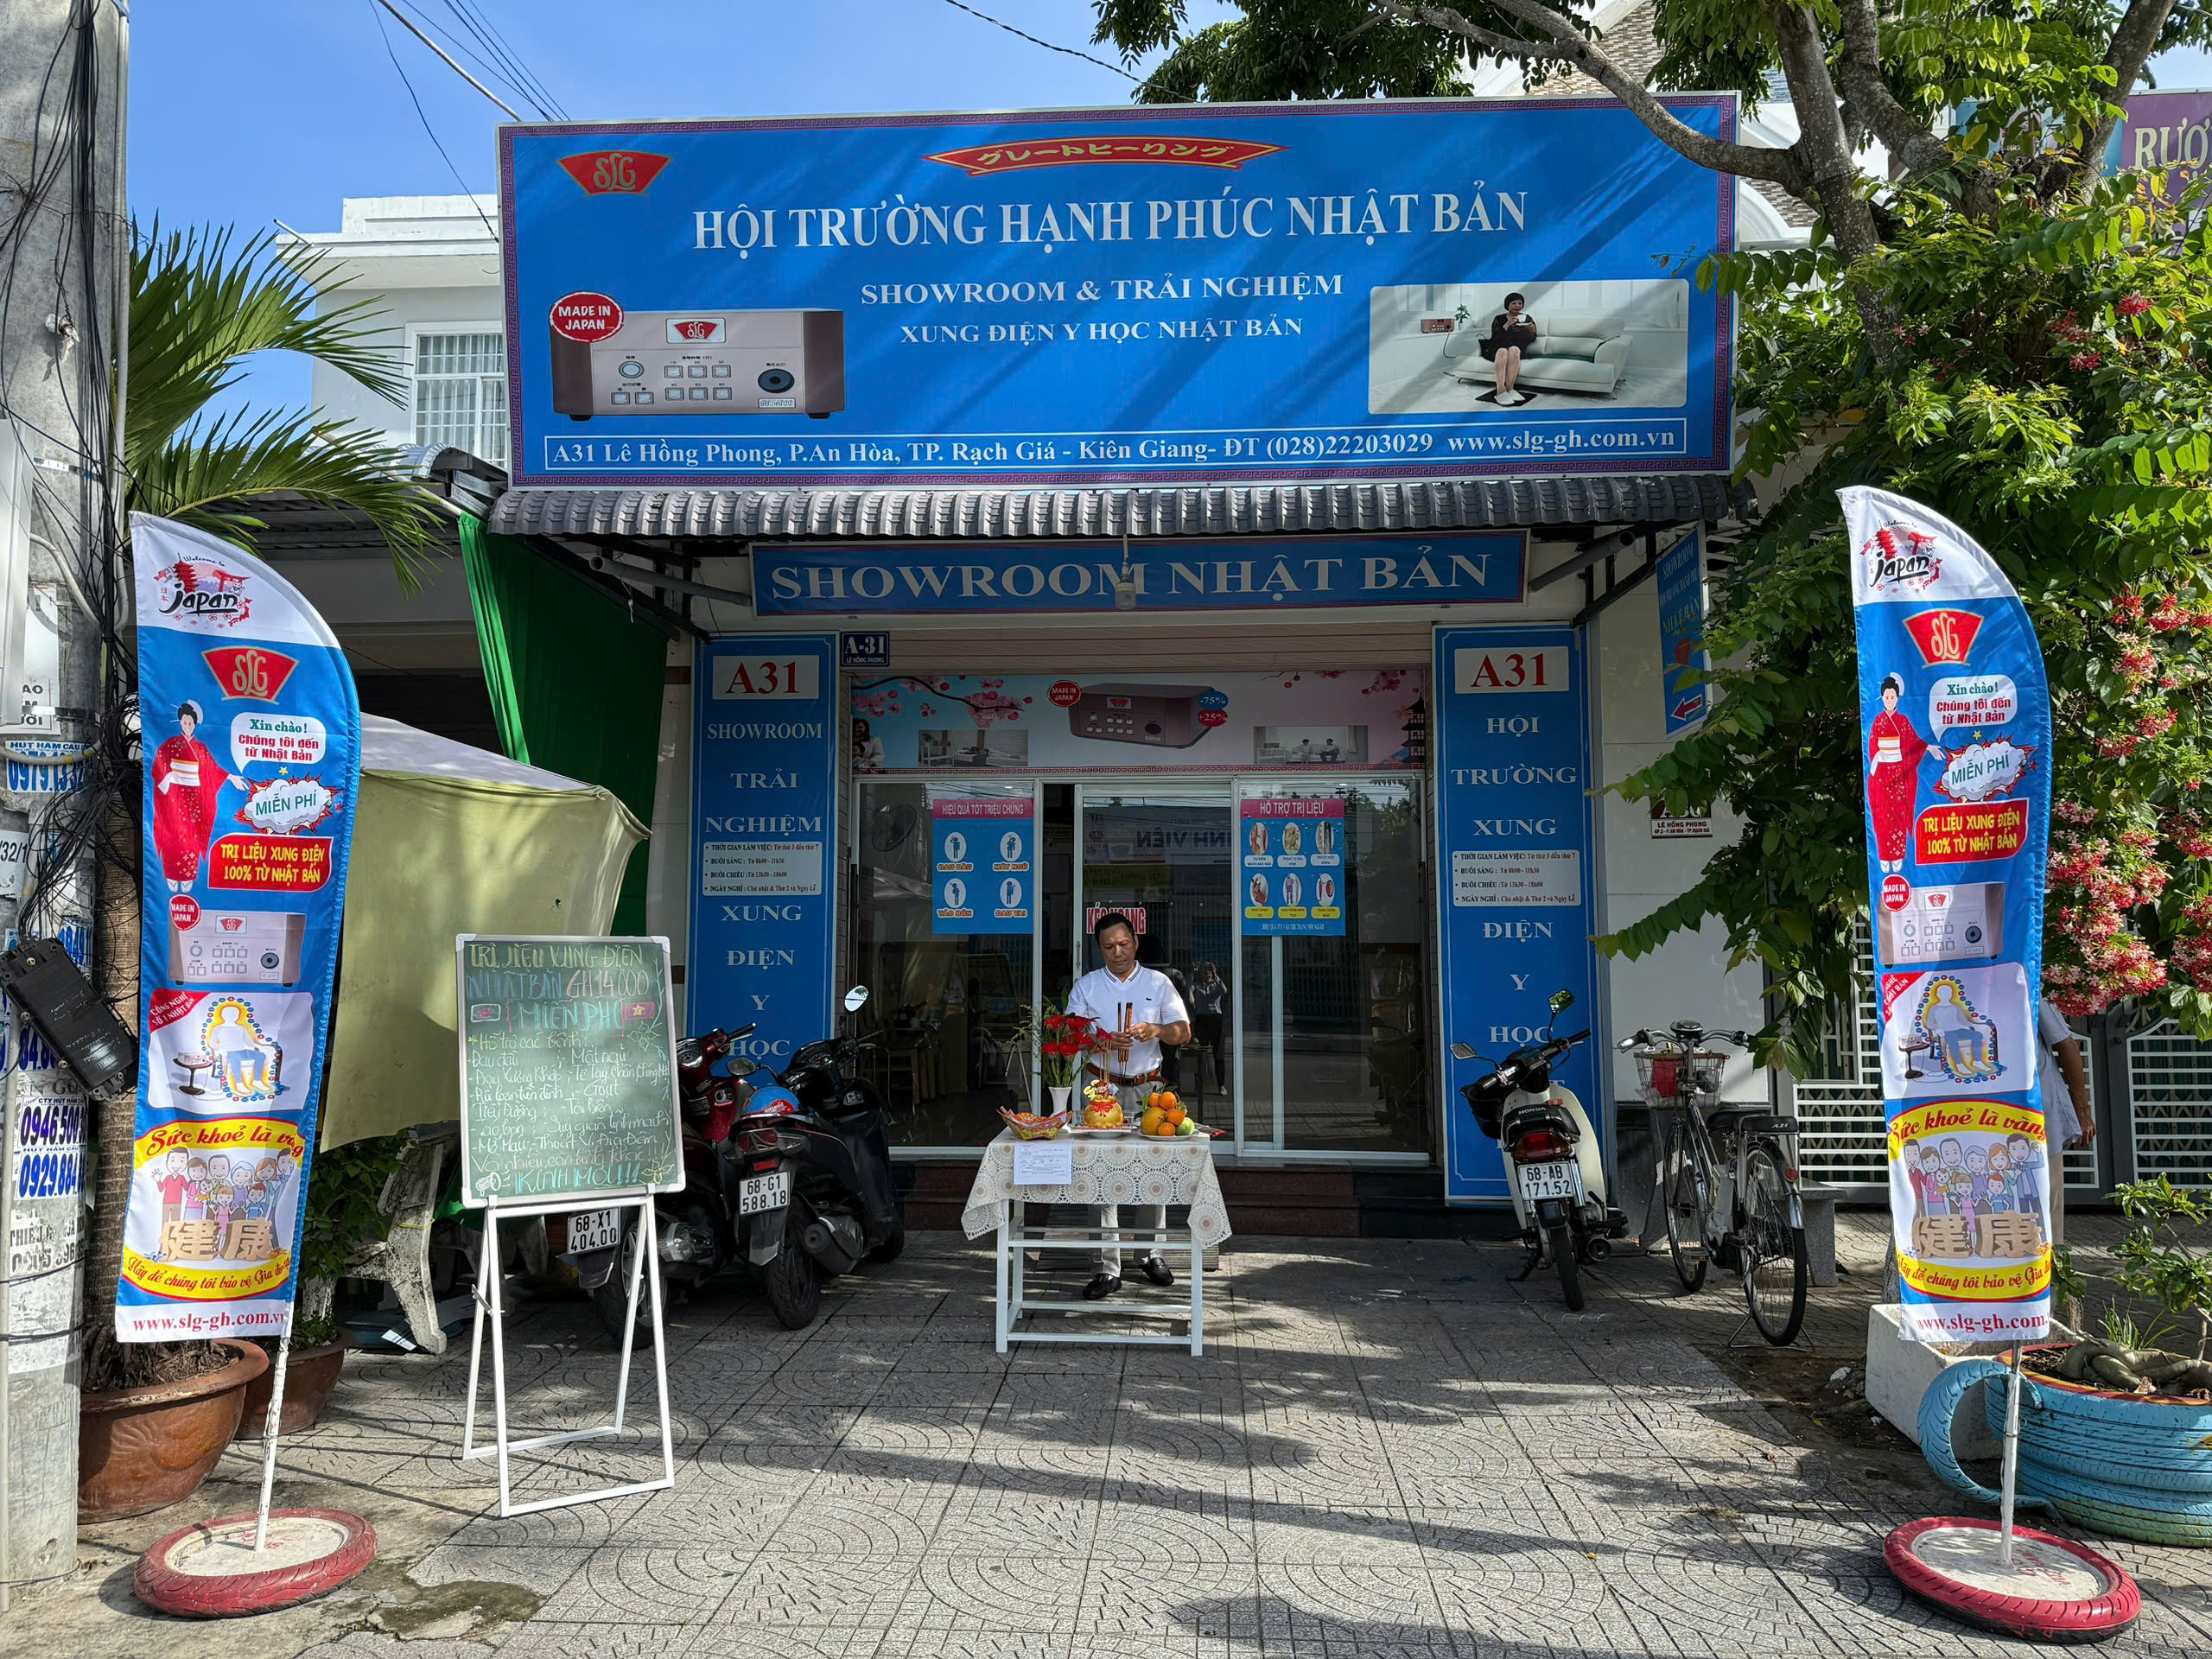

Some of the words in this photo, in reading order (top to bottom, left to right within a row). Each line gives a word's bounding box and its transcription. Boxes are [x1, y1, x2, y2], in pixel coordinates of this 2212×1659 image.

[2134, 117, 2212, 180] RƯỢ
[692, 203, 777, 259] HỘI
[788, 194, 988, 246] TRƯỜNG
[999, 201, 1133, 253] HẠNH
[1146, 186, 1273, 239] PHÚC
[1286, 188, 1418, 245] NHẬT
[1431, 180, 1528, 232] BẢN
[861, 281, 1065, 304] SHOWROOM
[1076, 280, 1101, 302] &
[1111, 272, 1191, 300] TRẢI
[1202, 272, 1344, 302] NGHIỆM
[558, 305, 595, 317] MADE
[598, 305, 611, 316] IN
[565, 319, 606, 330] JAPAN
[900, 324, 978, 344] XUNG
[988, 321, 1056, 346] ĐIỆN
[1063, 322, 1080, 340] Y
[1089, 321, 1150, 345] HỌC
[1158, 315, 1240, 344] NHẬT
[1246, 313, 1303, 337] BẢN
[552, 443, 594, 461] A31
[604, 442, 632, 461] Lê
[639, 438, 698, 467] Hồng
[706, 443, 782, 466] Phong,
[790, 443, 841, 461] P.An
[849, 442, 900, 464] Hòa,
[907, 442, 944, 461] TP.
[951, 441, 1007, 467] Rạch
[1015, 440, 1055, 461] Giá
[1079, 441, 1131, 460] Kiên
[1224, 438, 1261, 458] ĐT
[1267, 434, 1433, 461] (028)22203029
[1447, 429, 1675, 454] www.slg-gh.com.vn
[183, 556, 217, 564] Welcome
[772, 562, 1148, 600] SHOWROOM
[1166, 554, 1343, 601] NHẬT
[1360, 545, 1491, 589] BẢN
[844, 636, 885, 654] A-31
[726, 661, 799, 694] A31
[1471, 652, 1548, 688] A31
[1947, 683, 1967, 695] Xin
[1936, 701, 1971, 712] Chúng
[1974, 697, 1987, 709] tôi
[1991, 696, 2011, 709] đến
[250, 719, 272, 731] Xin
[1486, 715, 1540, 737] HỘI
[1942, 714, 1955, 725] từ
[1957, 712, 1982, 725] Nhật
[1985, 709, 2005, 722] Bản
[238, 734, 276, 747] Chúng
[279, 737, 294, 747] tôi
[298, 737, 319, 749] đến
[708, 723, 823, 740] SHOWROOM
[245, 747, 258, 758] từ
[262, 748, 288, 761] Nhật
[292, 750, 313, 760] Bản
[1451, 763, 1577, 785] TRƯỜNG
[1952, 759, 1983, 785] MIỄN
[1987, 750, 2009, 772] PHÍ
[731, 768, 798, 789] TRẢI
[256, 792, 290, 816] MIỄN
[295, 790, 316, 810] PHÍ
[705, 814, 823, 836] NGHIỆM
[1473, 818, 1557, 836] XUNG
[1923, 817, 1938, 836] TRỊ
[1942, 812, 1962, 835] LIỆU
[1967, 814, 1995, 830] XUNG
[1997, 807, 2020, 830] ĐIỆN
[1928, 838, 1951, 855] 100%
[1953, 835, 1967, 853] TỪ
[1969, 833, 1996, 855] NHẬT
[1998, 827, 2017, 849] BẢN
[220, 844, 238, 862] TRỊ
[243, 841, 266, 862] LIỆU
[270, 846, 298, 861] XUNG
[302, 843, 325, 865] ĐIỆN
[224, 866, 251, 881] 100%
[255, 863, 270, 880] TỪ
[271, 864, 298, 886] NHẬT
[302, 862, 321, 883] BẢN
[1884, 884, 1898, 893] MADE
[1885, 893, 1904, 902] JAPAN
[171, 904, 187, 912] MADE
[721, 906, 802, 921] XUNG
[1483, 919, 1553, 943] ĐIỆN
[726, 948, 795, 969] ĐIỆN
[1510, 974, 1530, 990] Y
[751, 995, 771, 1010] Y
[1489, 1026, 1554, 1047] HỌC
[728, 1039, 790, 1060] HỌC
[1518, 1107, 1547, 1116] HONDA
[1979, 1109, 1999, 1127] là
[146, 1128, 193, 1156] Sức
[250, 1125, 274, 1142] là
[1526, 1165, 1563, 1181] 68-AB
[747, 1174, 781, 1194] 68-G1
[1525, 1179, 1572, 1198] 171.52
[742, 1189, 786, 1213] 588.18
[575, 1210, 611, 1233] 68-X1
[160, 1217, 273, 1262] 健康
[571, 1227, 617, 1252] 404.00
[1912, 1210, 2042, 1259] 健康
[164, 1273, 197, 1292] chúng
[200, 1277, 216, 1289] tôi
[219, 1274, 237, 1288] bảo
[240, 1276, 252, 1287] vệ
[254, 1269, 272, 1284] Gia
[1926, 1271, 1959, 1291] chúng
[1963, 1276, 1979, 1288] tôi
[1983, 1274, 2005, 1288] bảo
[2009, 1273, 2022, 1287] vệ
